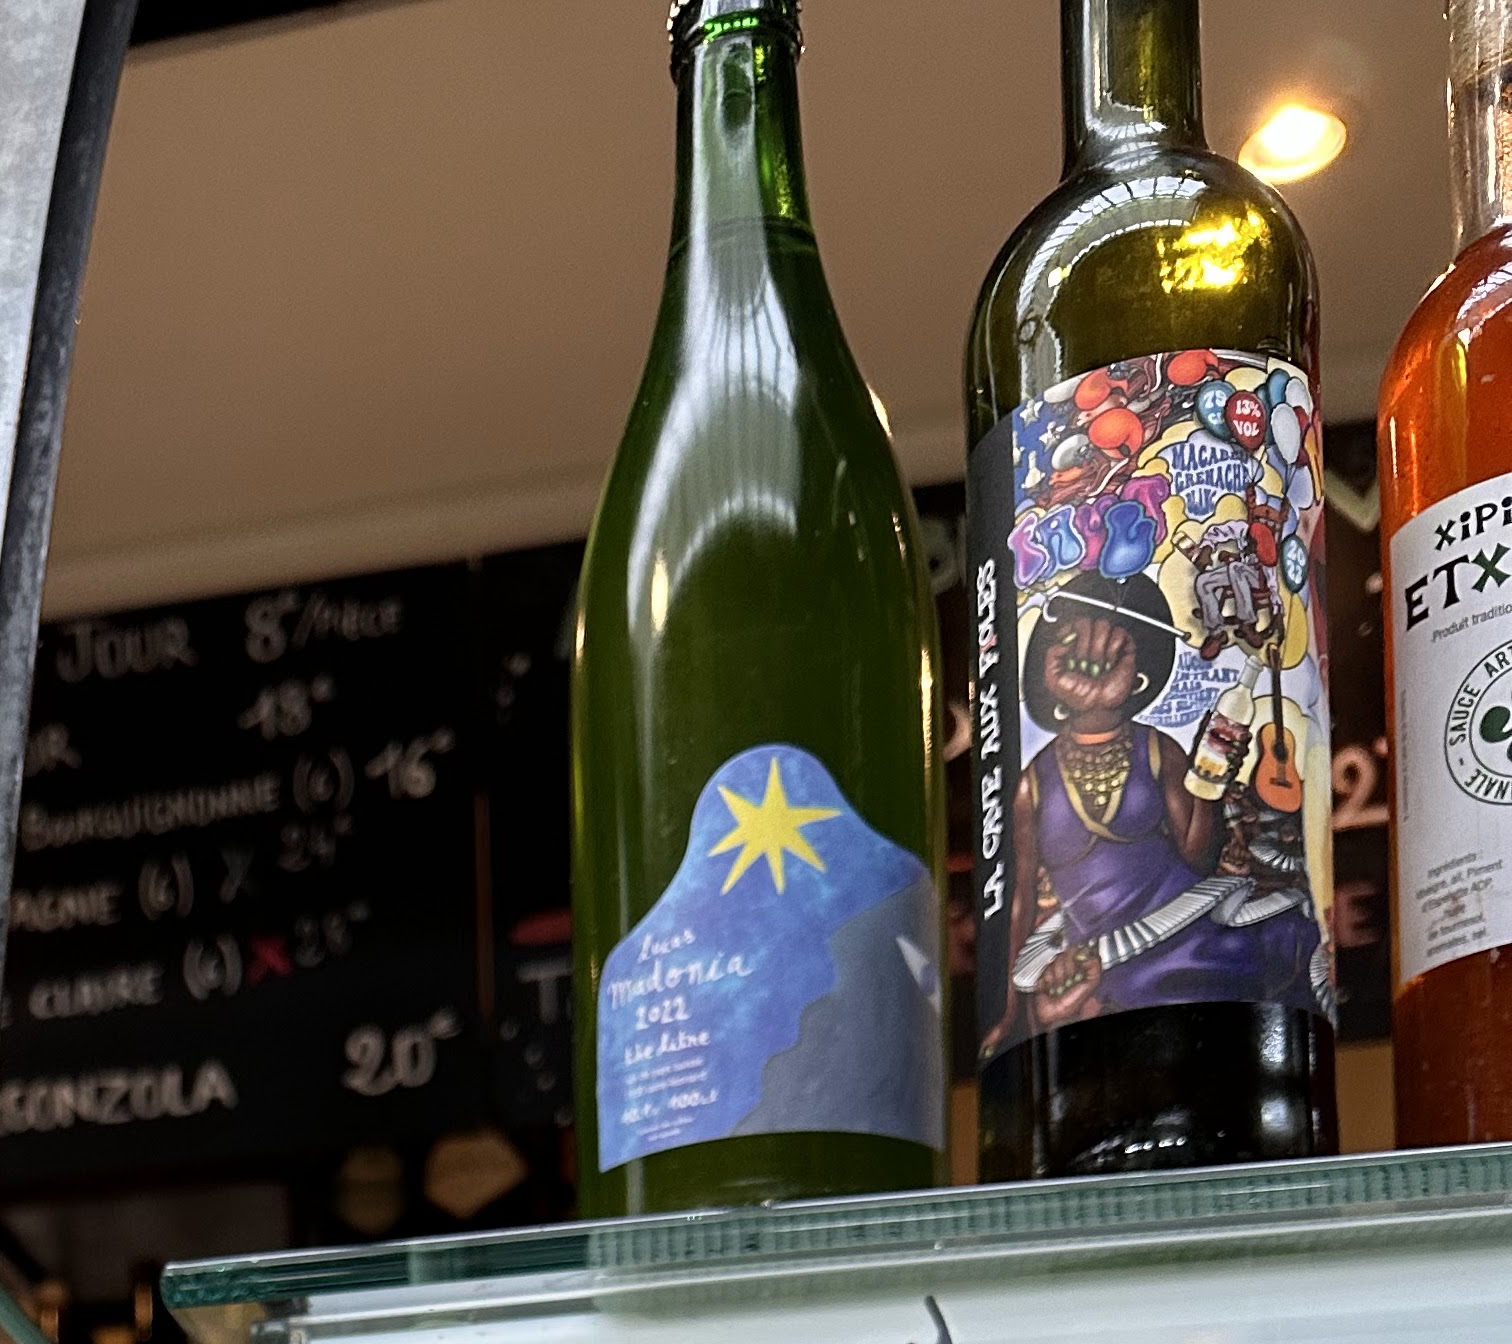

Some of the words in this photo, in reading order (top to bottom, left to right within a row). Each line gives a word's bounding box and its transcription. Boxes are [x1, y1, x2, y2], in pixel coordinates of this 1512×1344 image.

[1232, 419, 1261, 438] VOL
[1235, 398, 1262, 419] 13%
[979, 682, 1002, 761] AUX
[1448, 683, 1481, 747] SAUCE
[981, 764, 1004, 861] CAVE
[984, 861, 1006, 921] LA
